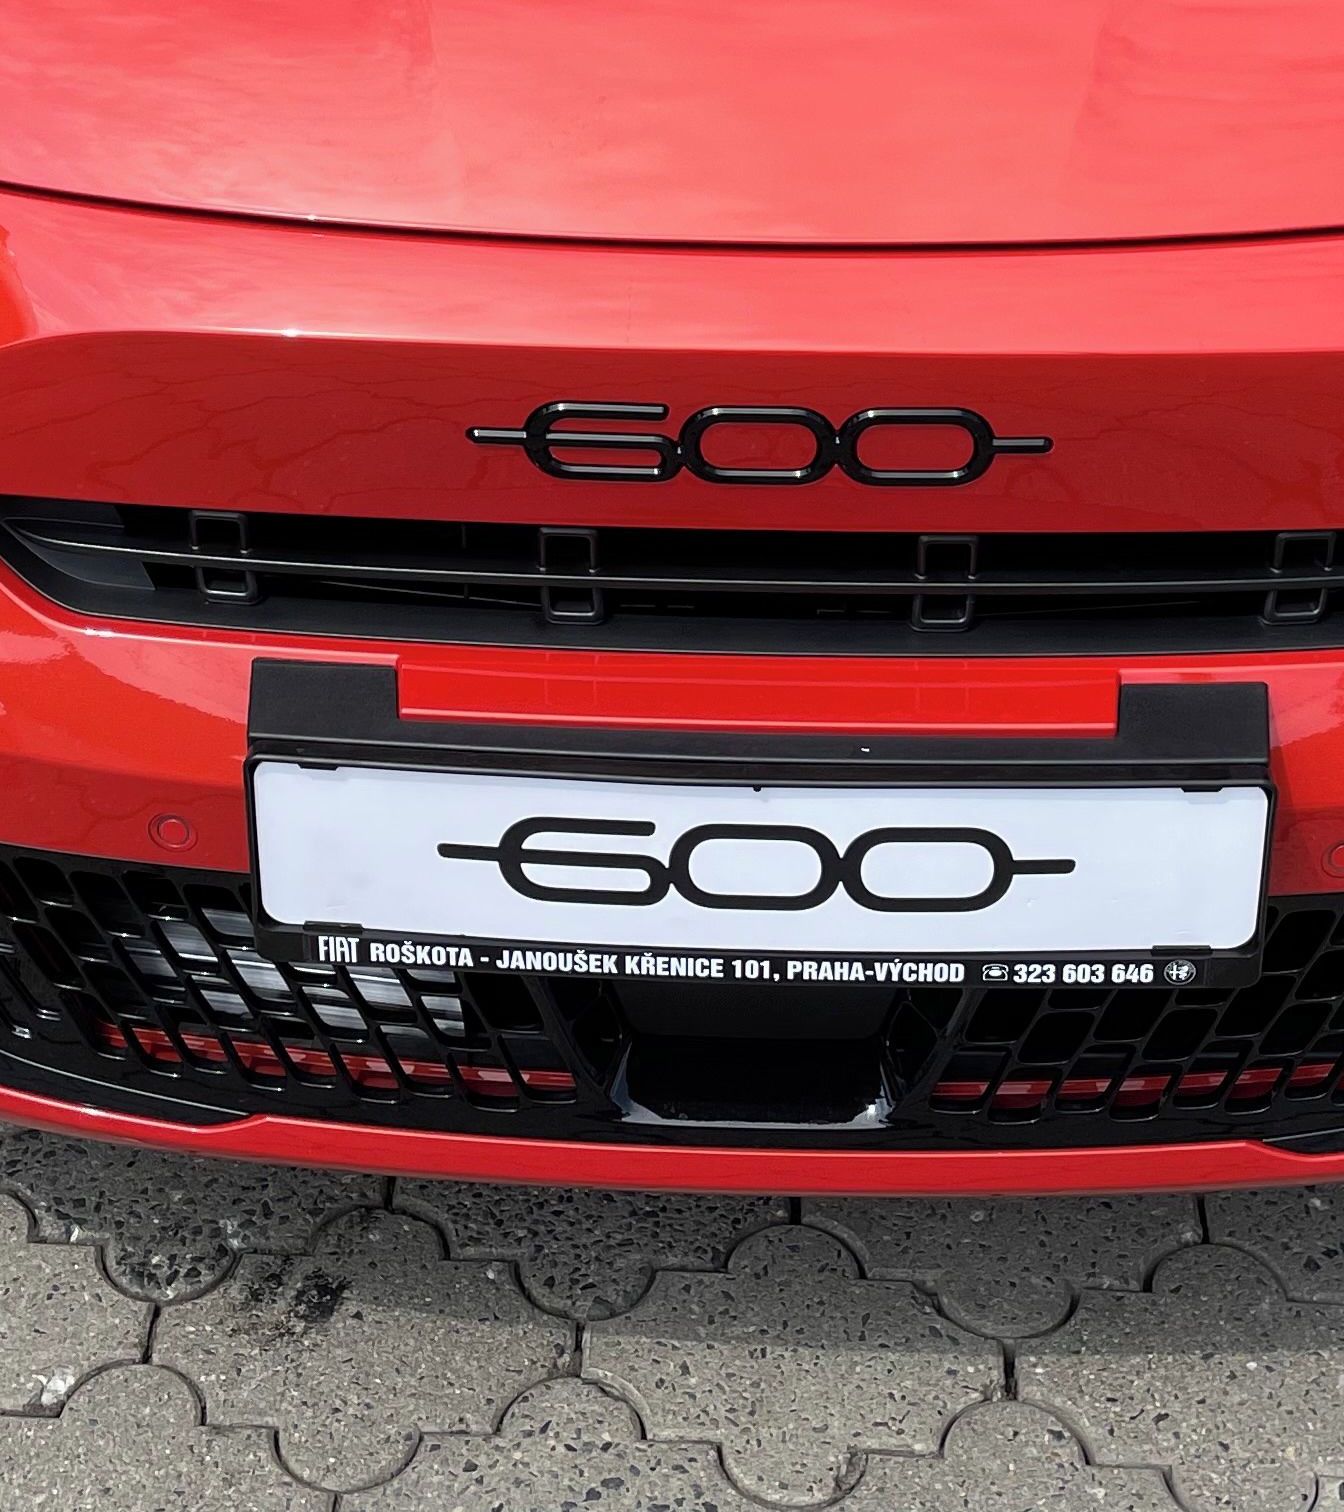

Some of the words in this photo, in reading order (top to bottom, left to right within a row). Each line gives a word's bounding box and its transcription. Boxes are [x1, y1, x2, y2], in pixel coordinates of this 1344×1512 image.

[523, 400, 996, 487] 600
[499, 815, 1013, 913] 600
[317, 935, 360, 963] FIAT
[369, 940, 474, 967] ROŠKOTA
[495, 949, 619, 975] JANOUŠEK
[624, 952, 724, 979] KŘENICE
[731, 959, 780, 982] 101,
[786, 958, 965, 983] PRAHA-VÝCHOD
[1012, 963, 1056, 984] 323
[1062, 963, 1105, 984] 603
[1111, 963, 1154, 984] 646
